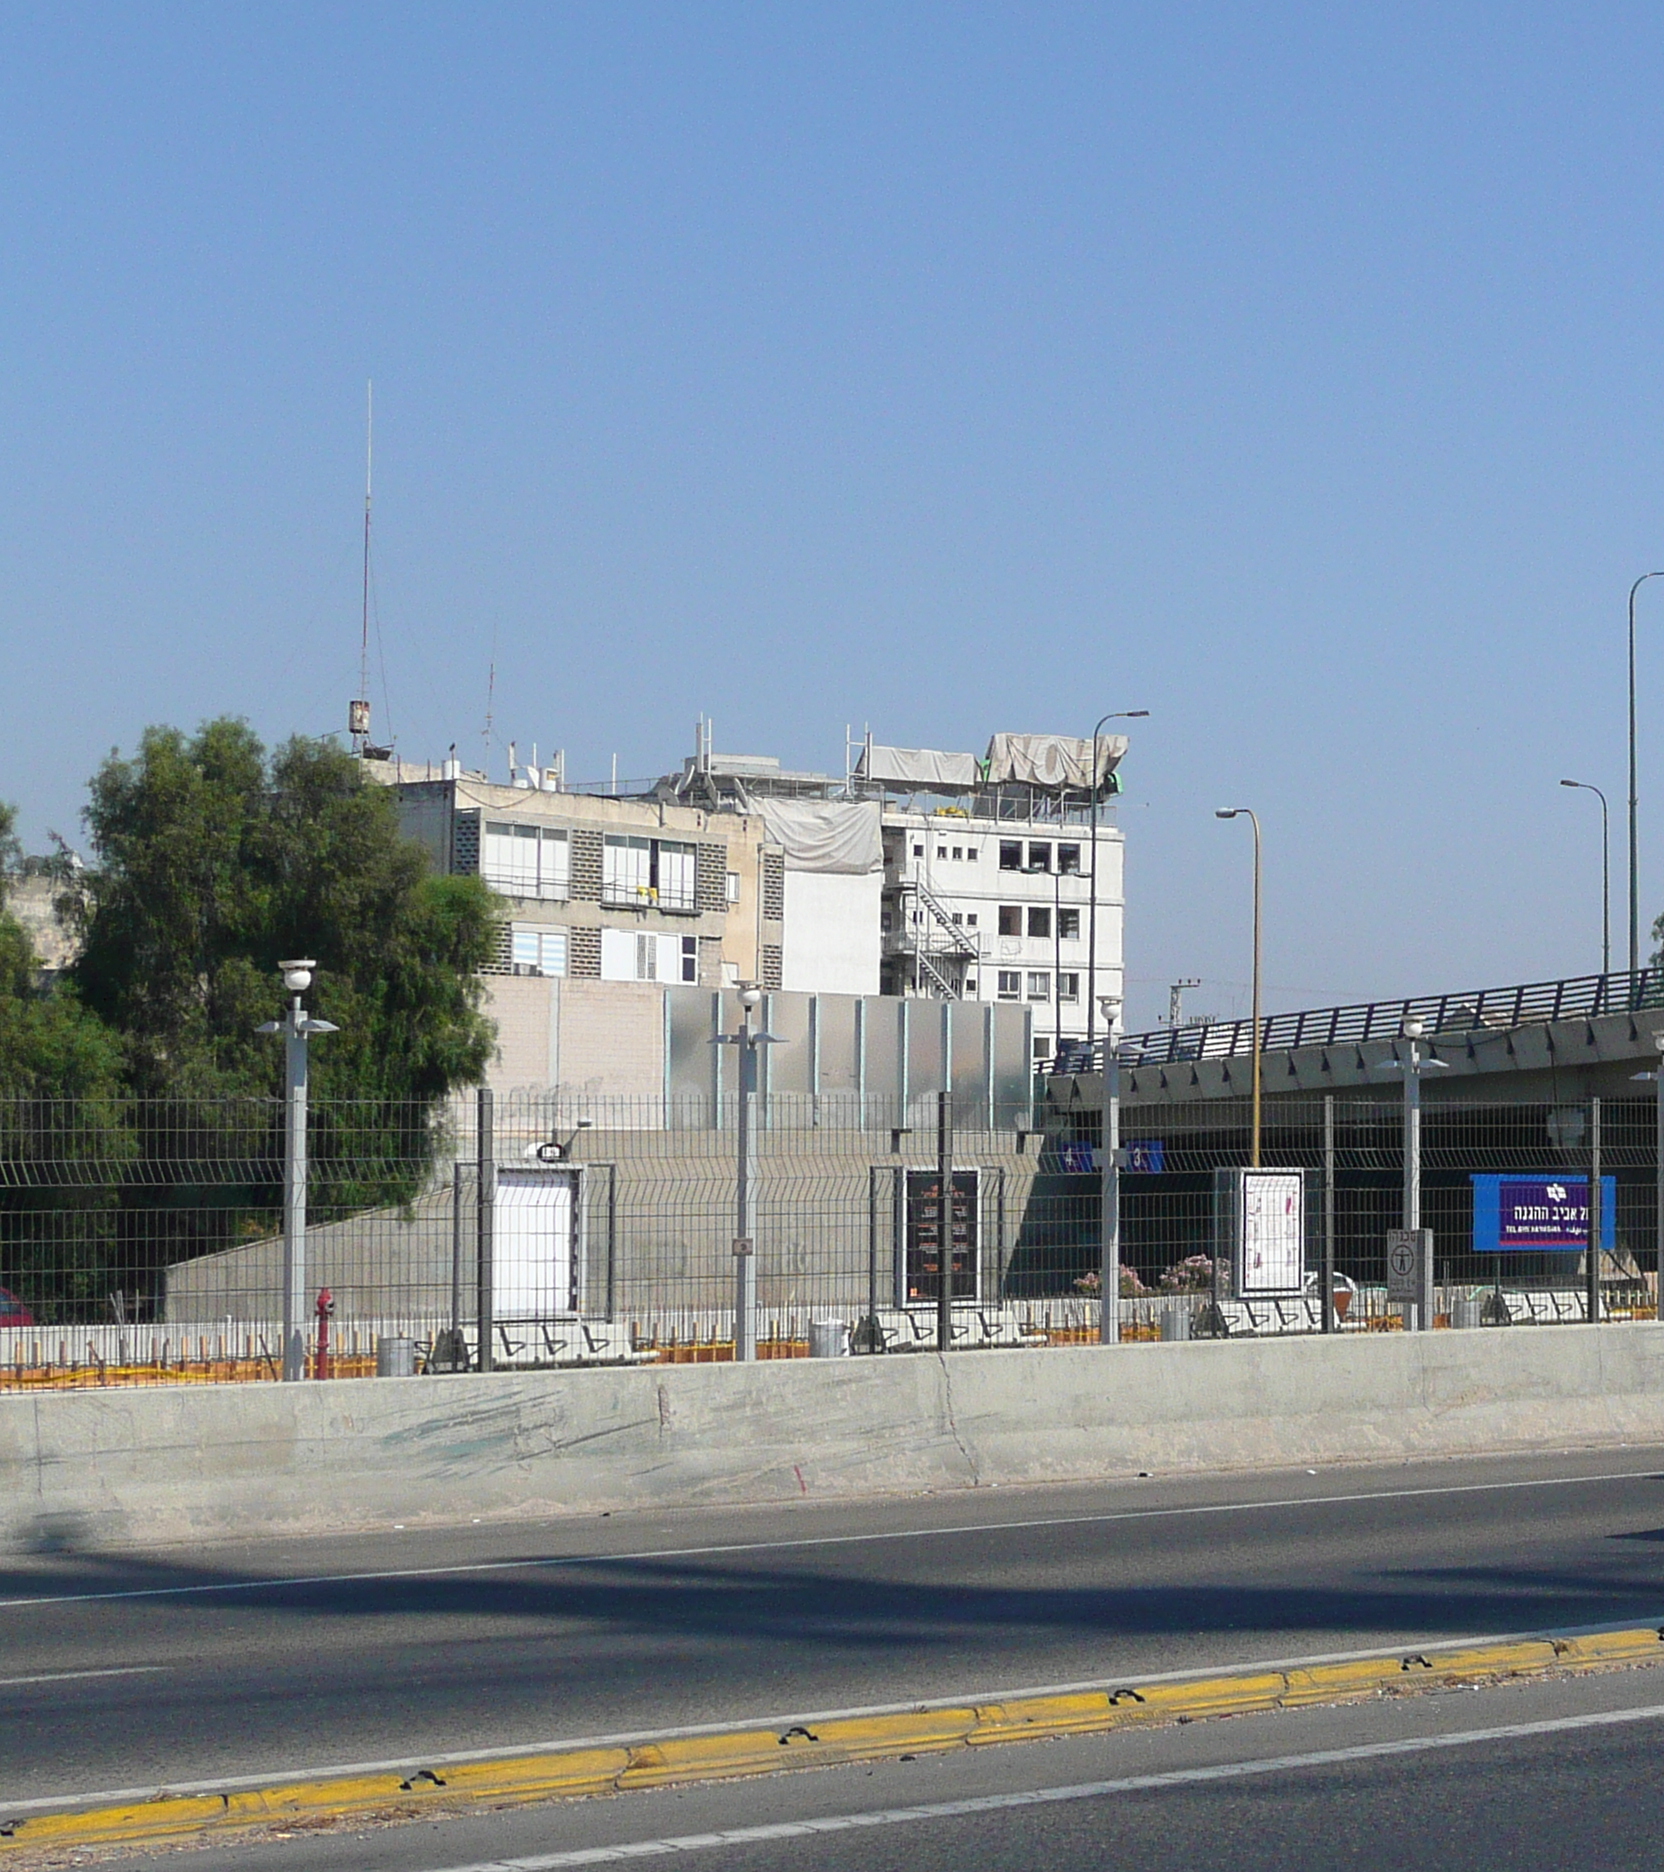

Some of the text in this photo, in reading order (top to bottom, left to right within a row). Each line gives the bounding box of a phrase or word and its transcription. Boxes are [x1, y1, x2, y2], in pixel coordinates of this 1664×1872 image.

[1133, 1147, 1141, 1167] 3
[1514, 1206, 1549, 1221] ההגנה
[1552, 1206, 1578, 1221] אביב
